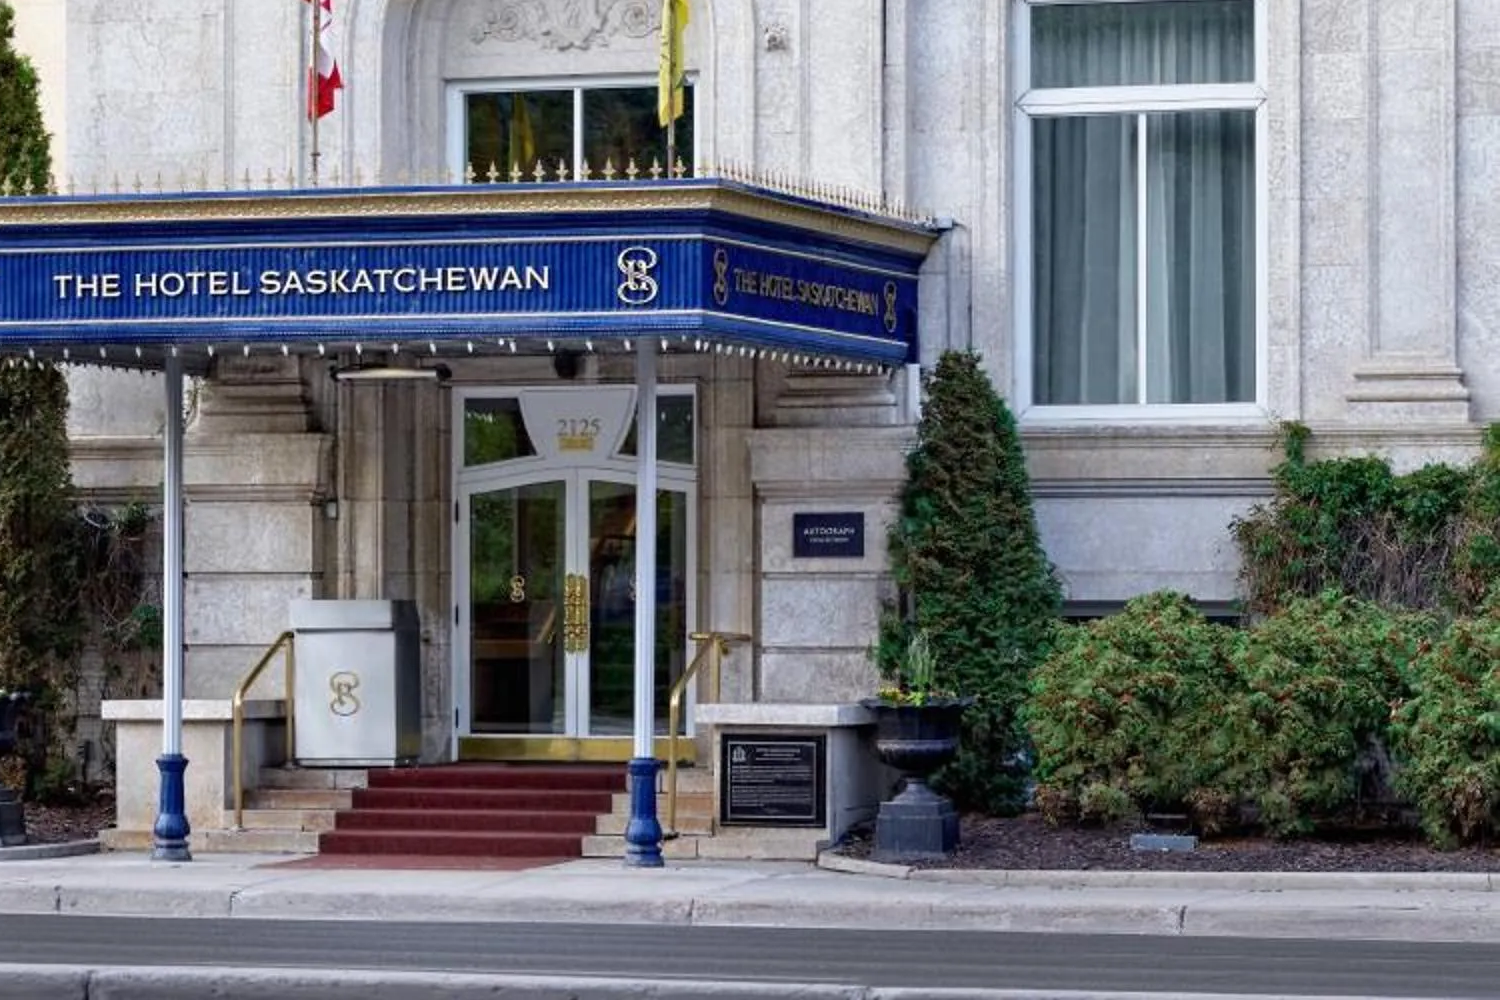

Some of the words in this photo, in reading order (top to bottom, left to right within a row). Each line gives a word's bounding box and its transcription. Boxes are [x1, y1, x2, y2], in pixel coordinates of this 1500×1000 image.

[53, 273, 121, 299] THE
[134, 271, 251, 298] HOTEL
[259, 265, 550, 296] SASKATCHEWAN
[733, 268, 758, 295] THE
[760, 272, 796, 301] HOTEL
[556, 418, 601, 438] 2125
